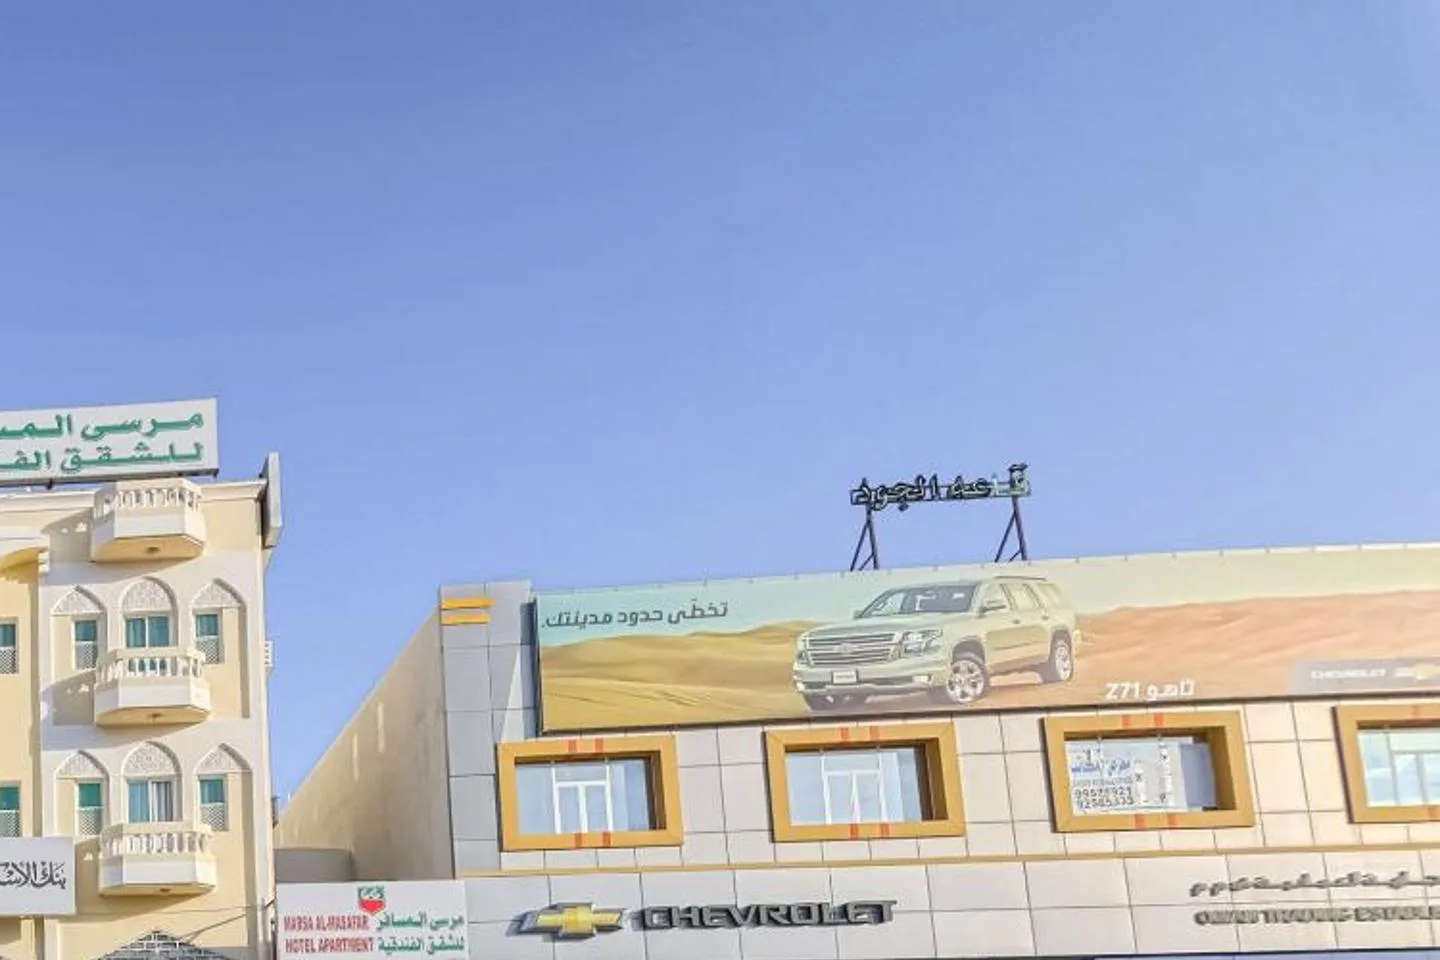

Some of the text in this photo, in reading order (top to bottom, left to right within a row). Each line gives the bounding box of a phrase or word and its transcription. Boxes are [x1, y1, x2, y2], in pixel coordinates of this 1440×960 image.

[80, 410, 204, 441] مرسى
[60, 440, 203, 473] للشقق
[1105, 681, 1140, 700] Z71
[283, 915, 314, 931] MARSA
[641, 900, 898, 929] CHEVROLET
[285, 936, 374, 953] HOTEL APARTMENT
